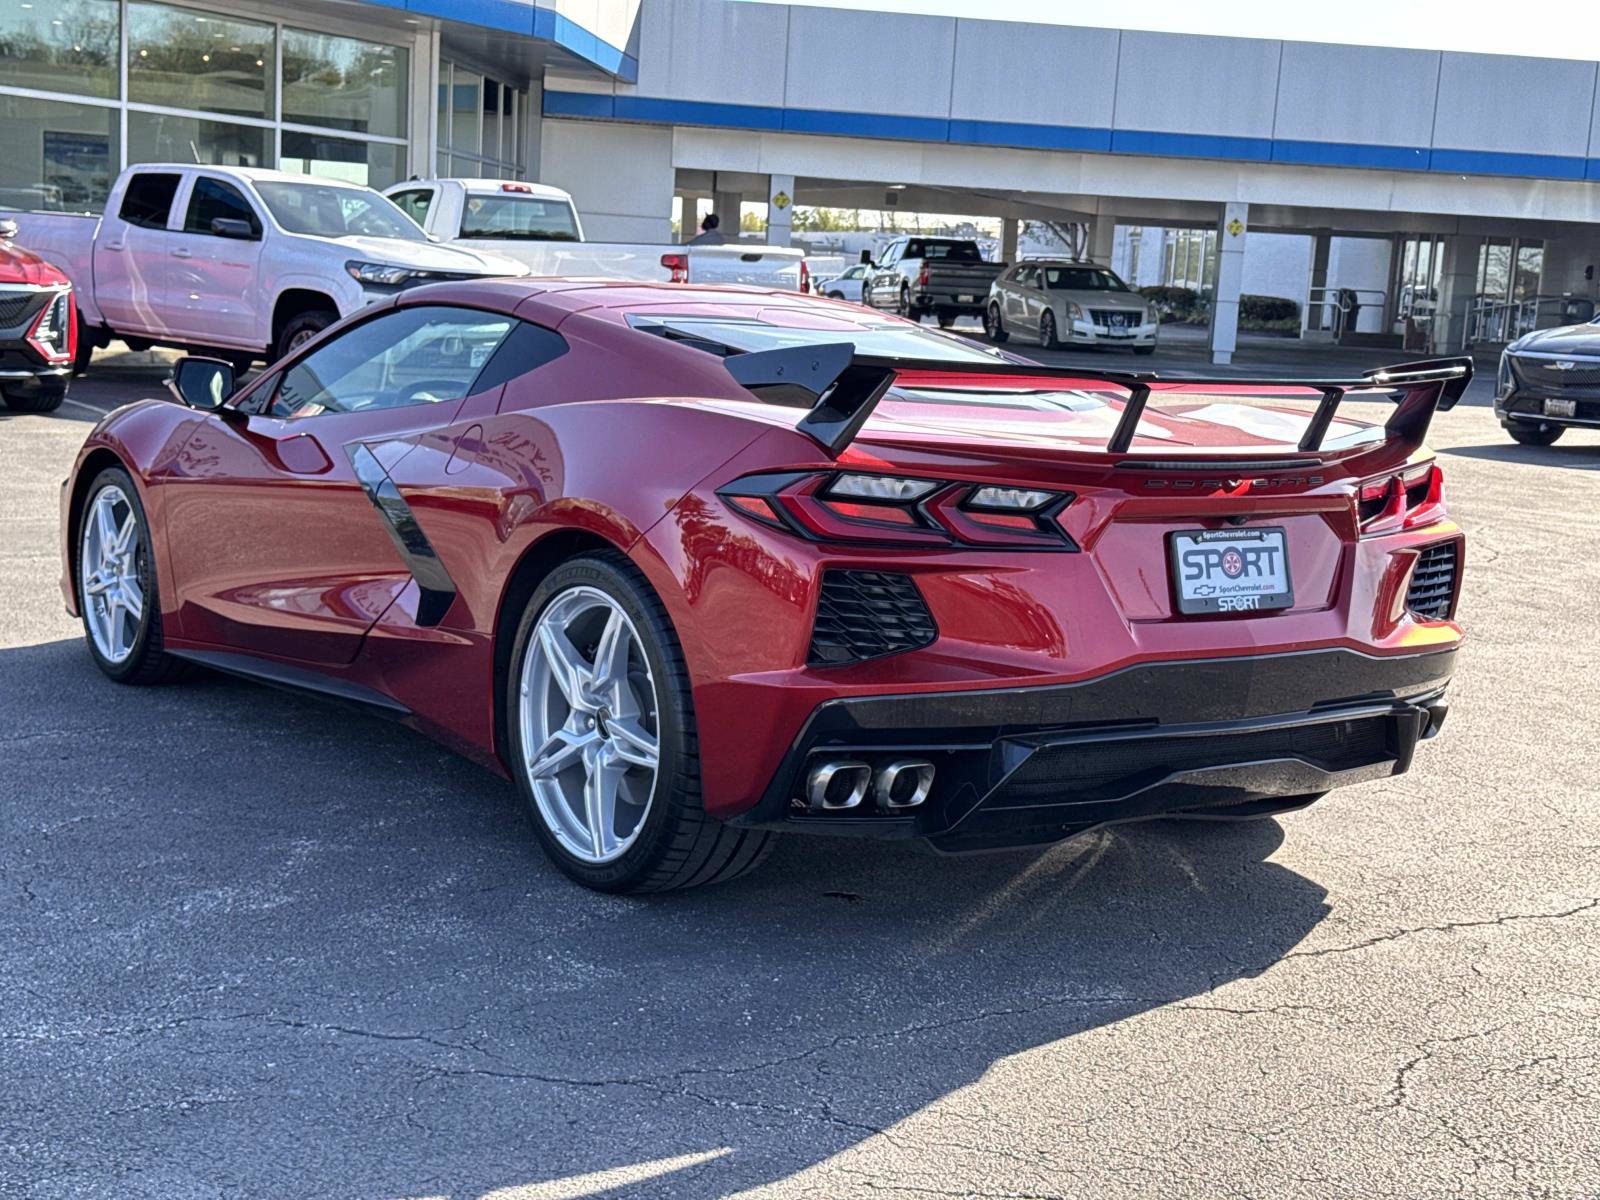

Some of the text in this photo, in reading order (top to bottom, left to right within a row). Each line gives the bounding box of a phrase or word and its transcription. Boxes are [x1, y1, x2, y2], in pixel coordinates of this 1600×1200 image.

[1144, 476, 1324, 489] CORVETTE
[1203, 530, 1261, 539] SportChevrolet.com
[1182, 546, 1279, 580] SPORT
[1219, 583, 1275, 593] SportChevrolet.com
[1218, 595, 1260, 611] SPORT
